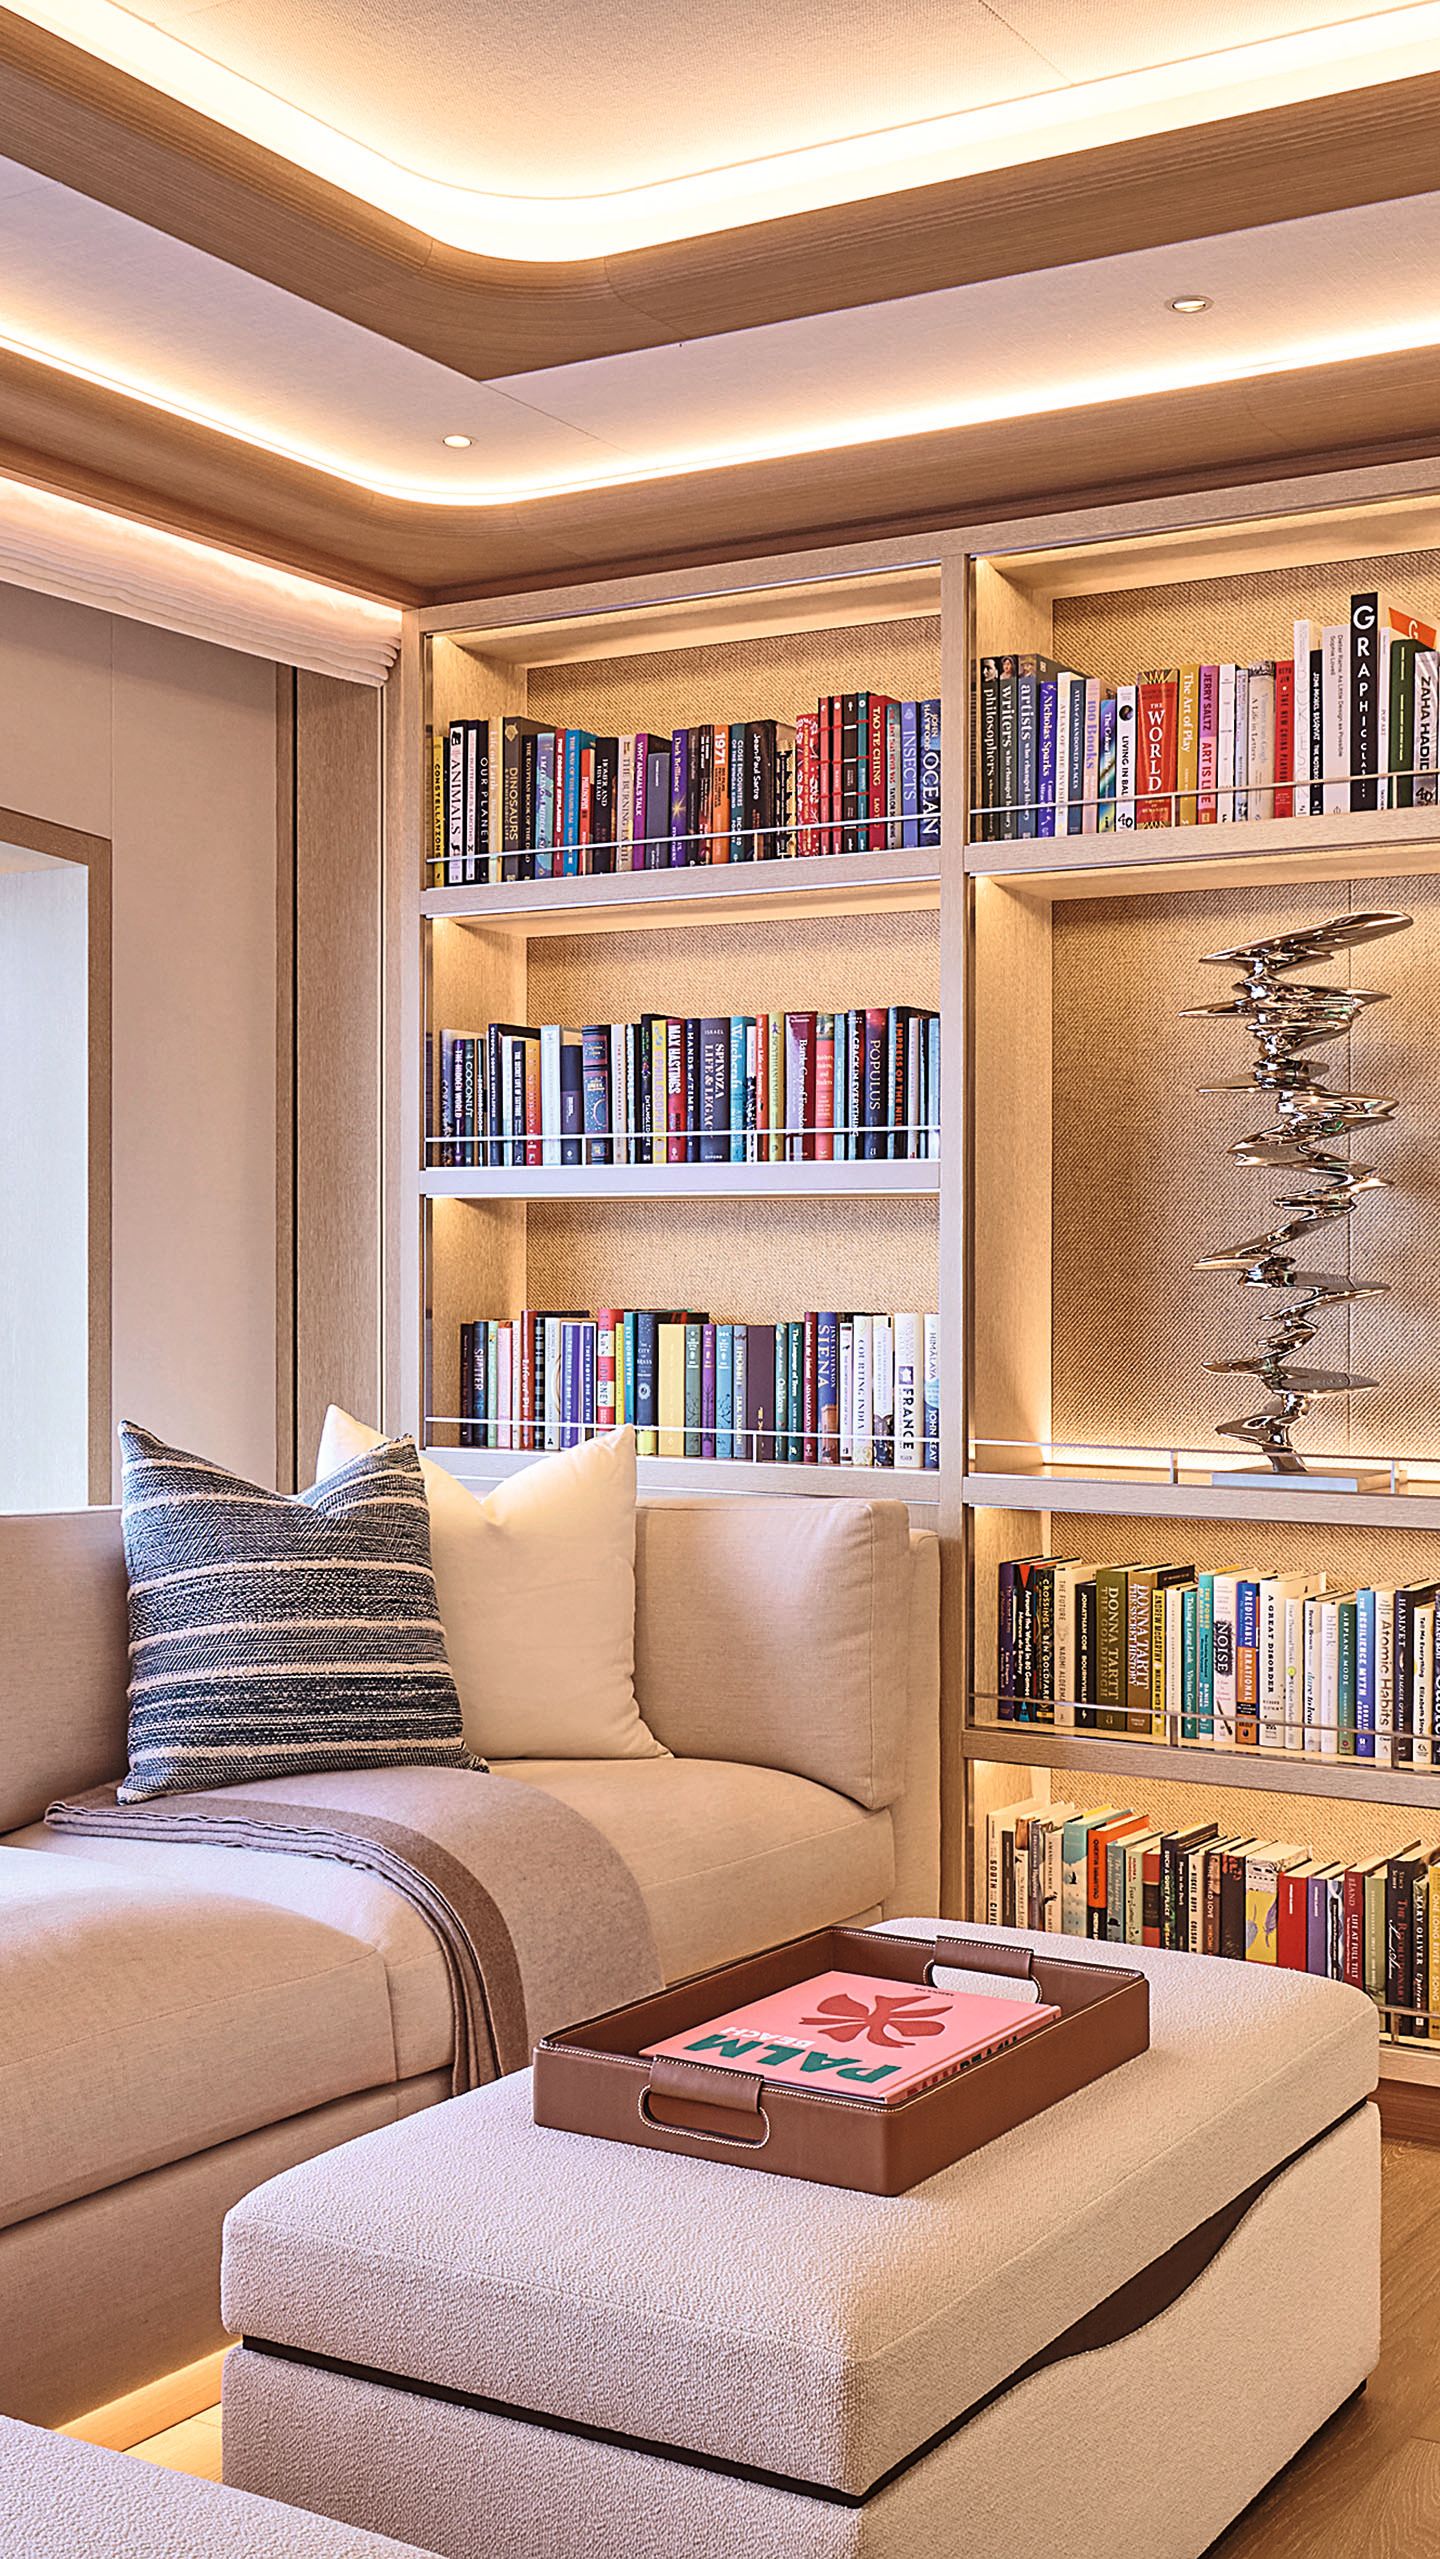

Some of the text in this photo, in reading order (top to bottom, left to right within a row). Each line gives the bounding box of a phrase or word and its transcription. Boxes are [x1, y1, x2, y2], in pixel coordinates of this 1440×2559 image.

[1000, 685, 1014, 748] writers
[1021, 684, 1034, 741] artists
[1042, 695, 1052, 740] Nicholas
[1179, 672, 1193, 752] The Art of Play
[1420, 676, 1432, 717] ZAHA
[716, 732, 726, 765] 1971
[752, 733, 761, 774] Jean-Paul
[872, 706, 881, 786] TAO CHING
[984, 688, 998, 776] philosophers
[1042, 742, 1052, 776] Sparks
[1086, 725, 1096, 769] Books
[1148, 708, 1166, 792] WORLD
[1201, 672, 1212, 804] JERRY SALTZ ART IS LIE
[480, 757, 488, 784] OUR
[752, 776, 760, 800] Sartre
[903, 731, 916, 801] INSECTS
[922, 752, 938, 834] OCEAN
[1122, 768, 1128, 778] IN
[450, 760, 461, 835] ANIMALS
[509, 768, 518, 840] DINOSAURS
[622, 780, 630, 826] BURNING
[668, 1024, 680, 1094] MAX HASTINGS
[704, 1045, 714, 1073] LIFE
[715, 1044, 724, 1099] SPINOZA
[731, 1024, 742, 1088] Witchcraft
[796, 1039, 808, 1094] Battle Cry of
[852, 1038, 860, 1066] CRACK
[870, 1040, 880, 1110] POPULUS
[896, 1070, 903, 1081] OF
[704, 1075, 714, 1086] &
[818, 1324, 830, 1388] SIENA
[585, 1398, 591, 1406] AT
[857, 1339, 865, 1429] COURTING INDIA
[902, 1388, 914, 1450] FRANCE
[928, 1409, 936, 1436] JOHN
[1128, 1584, 1138, 1686] THE SECRET HISTORY
[1136, 1585, 1148, 1690] DONNA TARTT
[1186, 1598, 1194, 1622] Taking
[1186, 1628, 1194, 1645] Long
[1326, 1615, 1336, 1646] blink
[1025, 1661, 1032, 1670] 80
[1108, 1586, 1120, 1700] DONNA TARTT
[1217, 1623, 1228, 1672] NOISE
[1244, 1591, 1252, 1701] PREDICTABLY IRRATIONAL
[1378, 1620, 1392, 1726] Atomic Habits
[1351, 1931, 1358, 1940] AT
[1415, 1895, 1424, 2009] MARY OLIVER Upstream
[684, 2034, 902, 2084] PALM
[714, 2026, 816, 2048] BEACH
